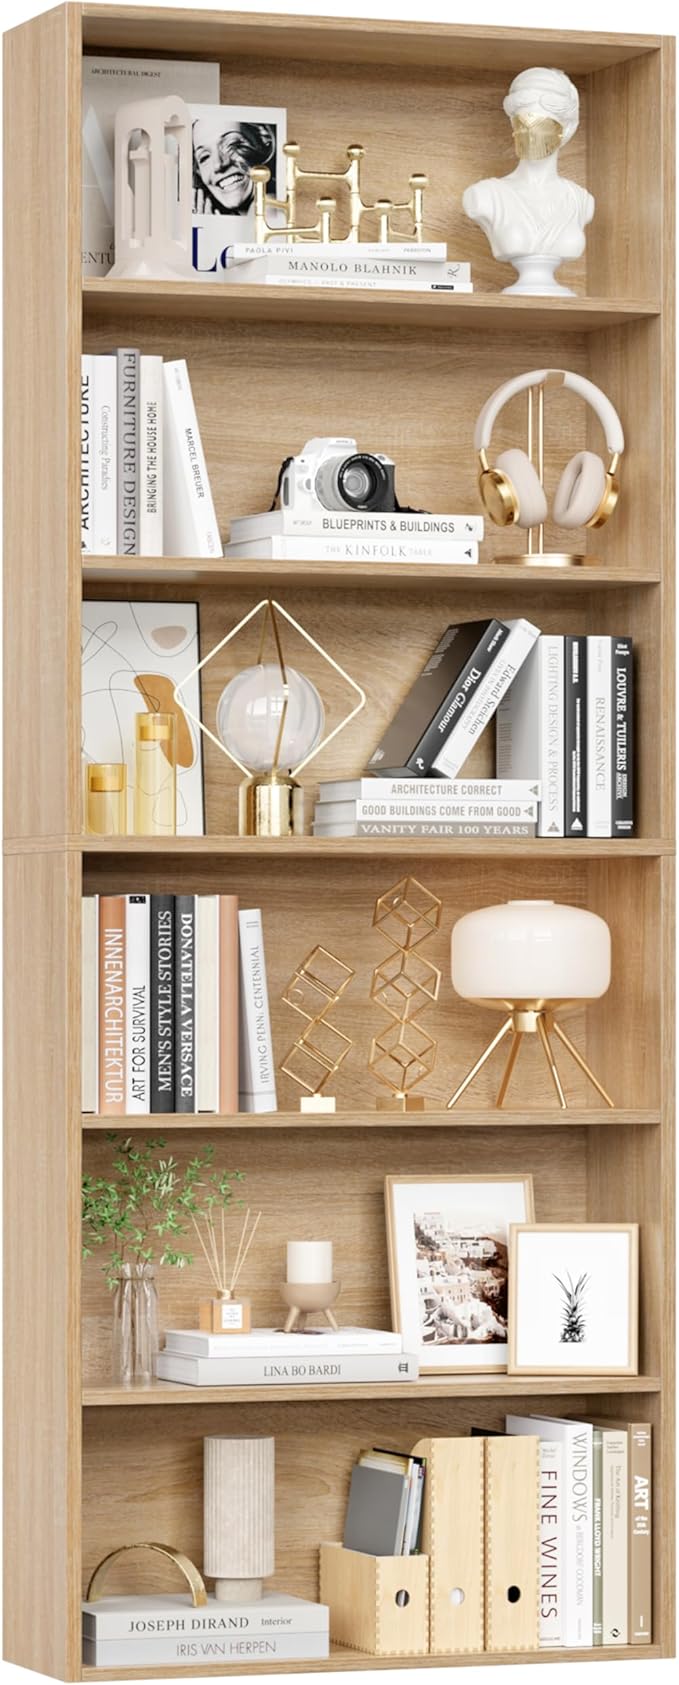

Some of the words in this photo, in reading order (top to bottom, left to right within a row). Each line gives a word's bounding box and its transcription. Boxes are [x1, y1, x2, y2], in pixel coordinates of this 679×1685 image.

[288, 260, 348, 273] MANOLO
[354, 262, 417, 275] BLAHNIK
[99, 405, 111, 456] Constructing
[123, 352, 136, 473] FURNITURE
[146, 402, 157, 425] HOME
[146, 426, 157, 454] HOUSE
[146, 454, 157, 471] THE
[184, 427, 198, 463] MARCEL
[191, 464, 205, 499] BREUER
[146, 475, 157, 513] BRINGING
[123, 481, 136, 556] DESIGN
[322, 517, 387, 532] BLUEPRINTS
[389, 520, 398, 531] &
[400, 519, 455, 533] BUILDINGS
[345, 544, 407, 557] KINFOLK
[461, 667, 482, 691] Dior
[494, 663, 516, 702] Edward
[547, 645, 560, 700] LIGHTING
[616, 667, 627, 712] LOUVRE
[437, 691, 467, 734] Glamour
[468, 698, 497, 736] Steichen
[547, 704, 560, 746] DESIGN
[595, 697, 606, 791] RENAISSANCE
[391, 783, 459, 795] ARCHITECTURE
[461, 784, 503, 796] CORRECT
[547, 761, 560, 812] PROCESS
[361, 824, 417, 834] VANITY
[421, 824, 454, 834] FAIR
[458, 825, 480, 834] 100
[482, 825, 529, 835] YEARS
[362, 805, 387, 815] GOOD
[389, 805, 437, 816] BUILDINGS
[439, 806, 466, 816] COME
[468, 806, 494, 816] FROM
[496, 806, 521, 817] GOOD
[158, 910, 172, 981] STORIES
[181, 913, 193, 1016] DONATELLA
[250, 945, 263, 1010] CENTENNIAL
[104, 928, 124, 1104] INNENARCHITEKTUR
[131, 984, 146, 1042] SURVIVAL
[158, 984, 172, 1037] STYLE
[131, 1047, 146, 1077] FOR
[158, 1045, 172, 1092] MEN'S
[181, 1019, 193, 1097] VERSACE
[256, 1045, 268, 1084] IRVING
[131, 1077, 146, 1102] ART
[263, 1365, 289, 1377] LINA
[291, 1365, 306, 1377] BO
[308, 1364, 342, 1376] BARDI
[541, 1470, 557, 1525] FINE
[572, 1431, 588, 1524] WINDOWS
[634, 1475, 649, 1510] ART
[541, 1536, 557, 1619] WINES
[128, 1619, 185, 1633] JOSEPH
[191, 1617, 249, 1630] DIRAND
[260, 1617, 293, 1627] Interior
[176, 1643, 198, 1657] IRIS
[200, 1642, 226, 1656] VAN
[229, 1640, 277, 1655] HERPEN
